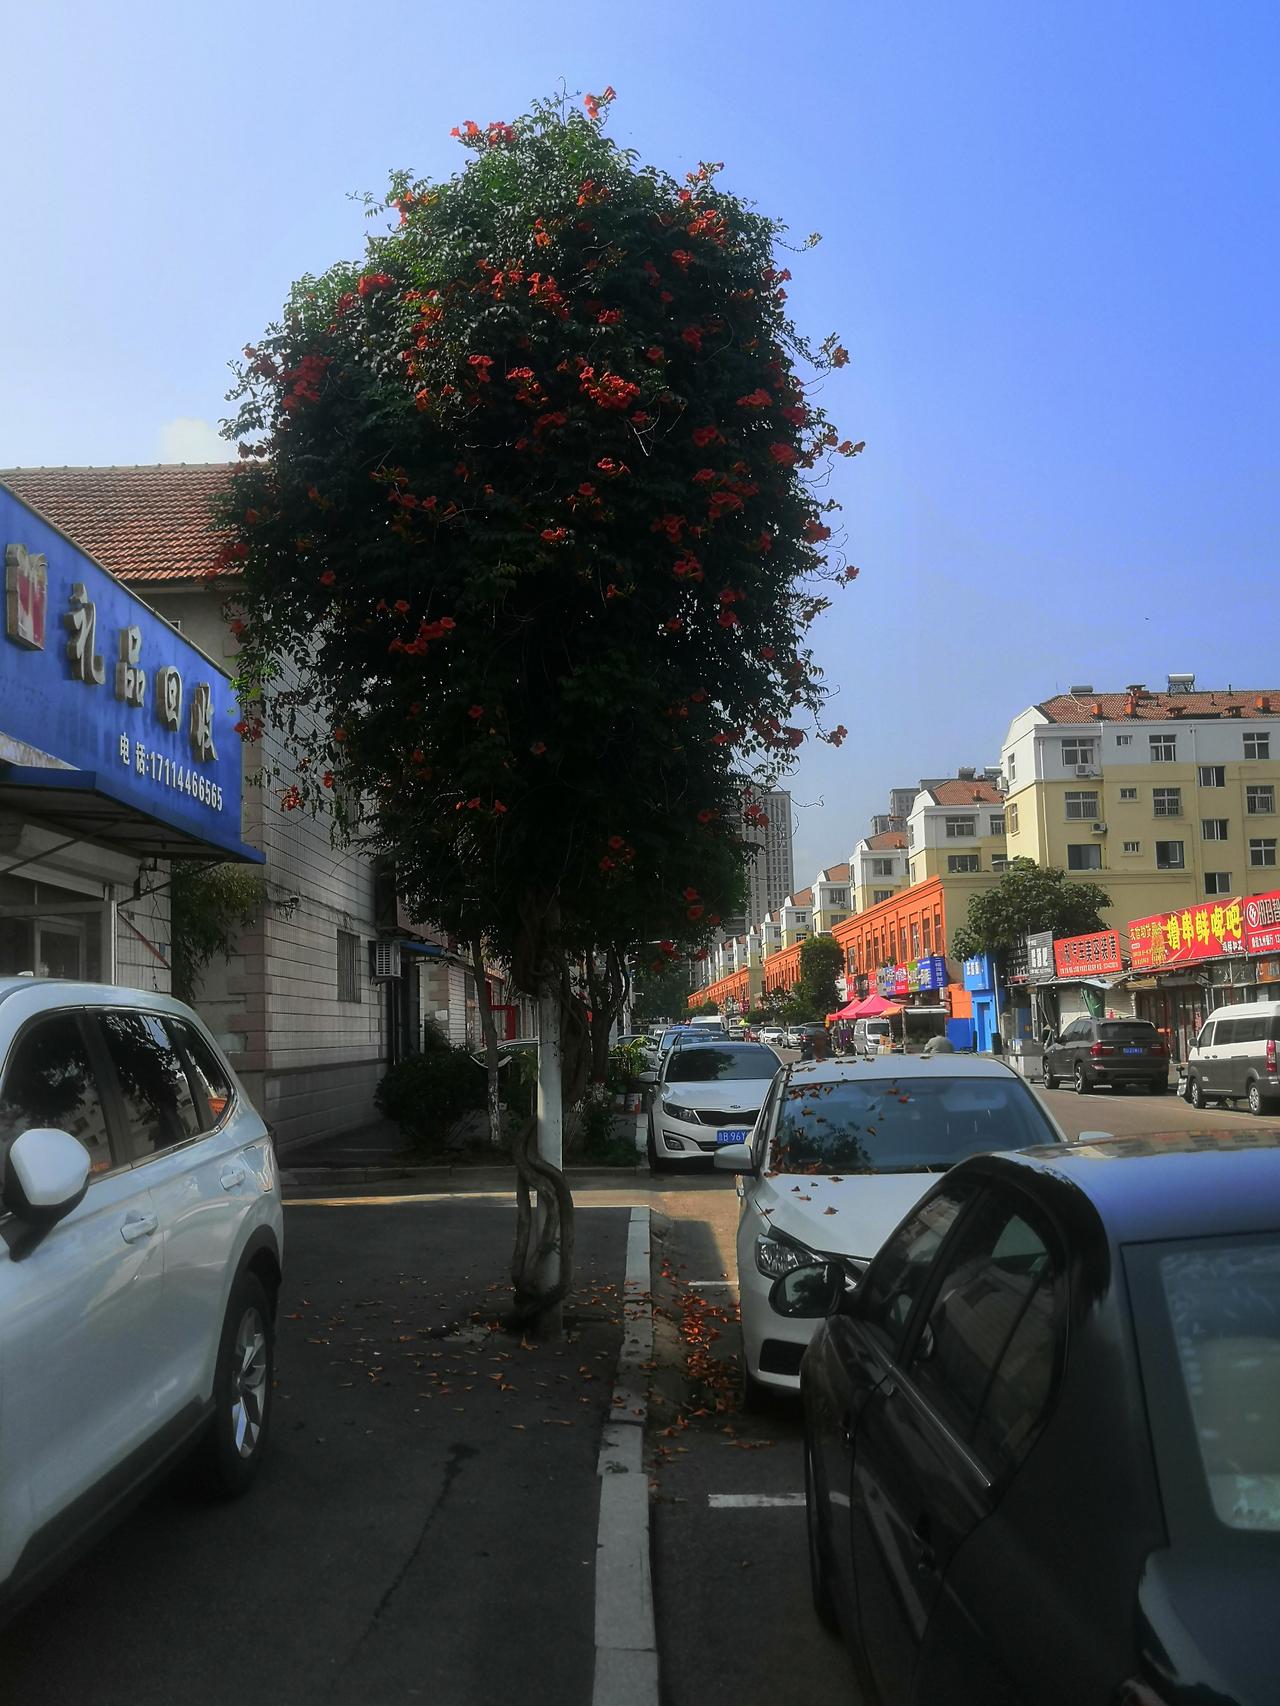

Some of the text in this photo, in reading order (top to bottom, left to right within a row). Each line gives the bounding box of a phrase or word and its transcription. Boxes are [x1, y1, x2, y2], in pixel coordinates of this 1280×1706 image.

[64, 583, 218, 761] 礼品回收
[120, 732, 223, 812] 电话:17114466565
[718, 1130, 748, 1142] 鲁B96Y
